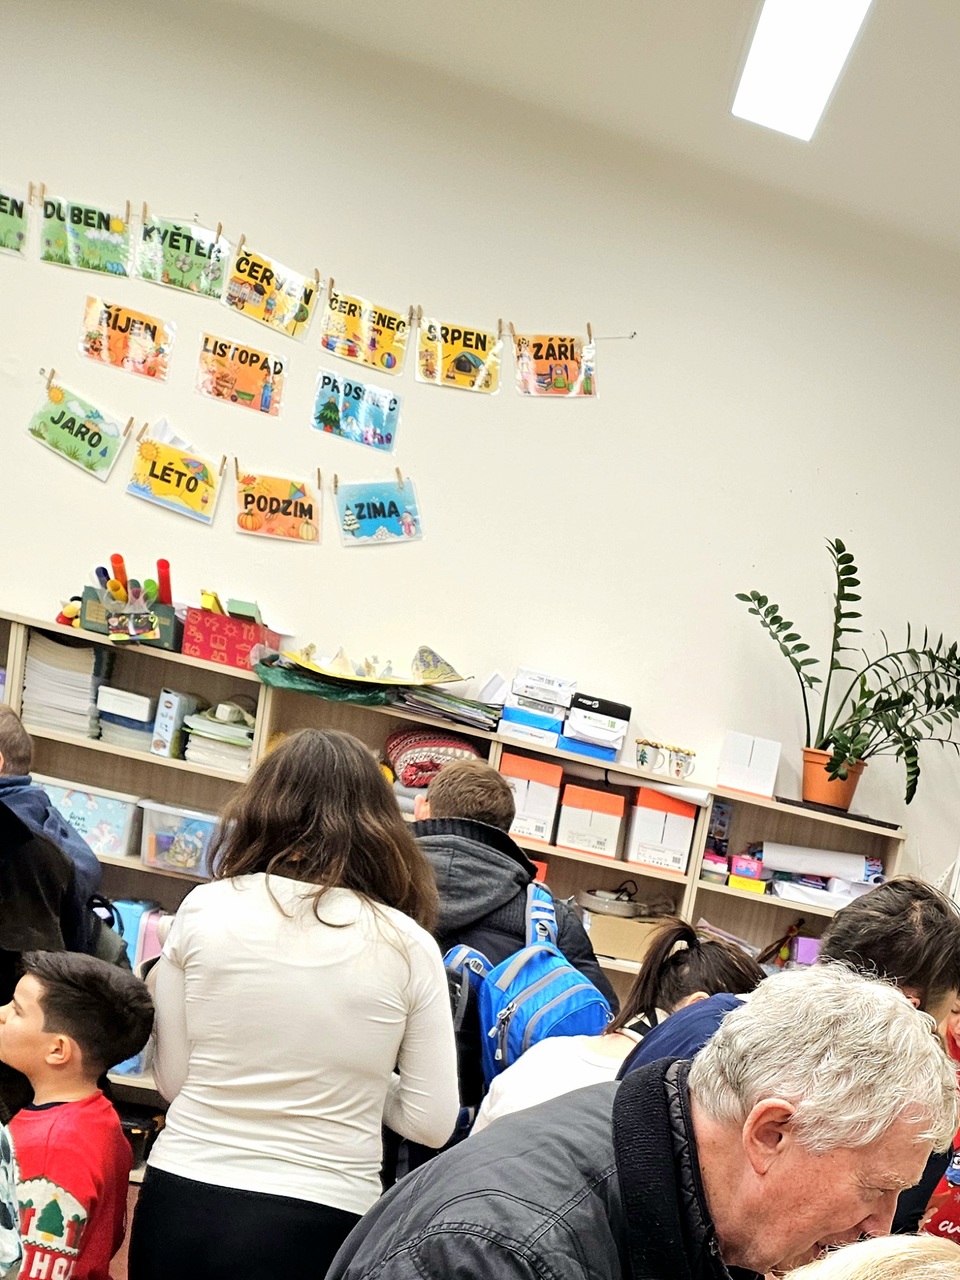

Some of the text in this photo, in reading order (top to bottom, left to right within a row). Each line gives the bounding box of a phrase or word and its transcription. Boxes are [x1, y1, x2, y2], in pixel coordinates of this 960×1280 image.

[43, 200, 111, 232] DUBEN
[98, 303, 157, 342] ŘÍJEN
[426, 325, 487, 352] SRPEN
[203, 337, 283, 375] LISTOPAD
[532, 337, 575, 361] ZÁŘÍ
[50, 410, 101, 449] JARO
[149, 460, 199, 493] LÉTO
[244, 493, 313, 520] PODZIM
[353, 501, 400, 521] ZIMA
